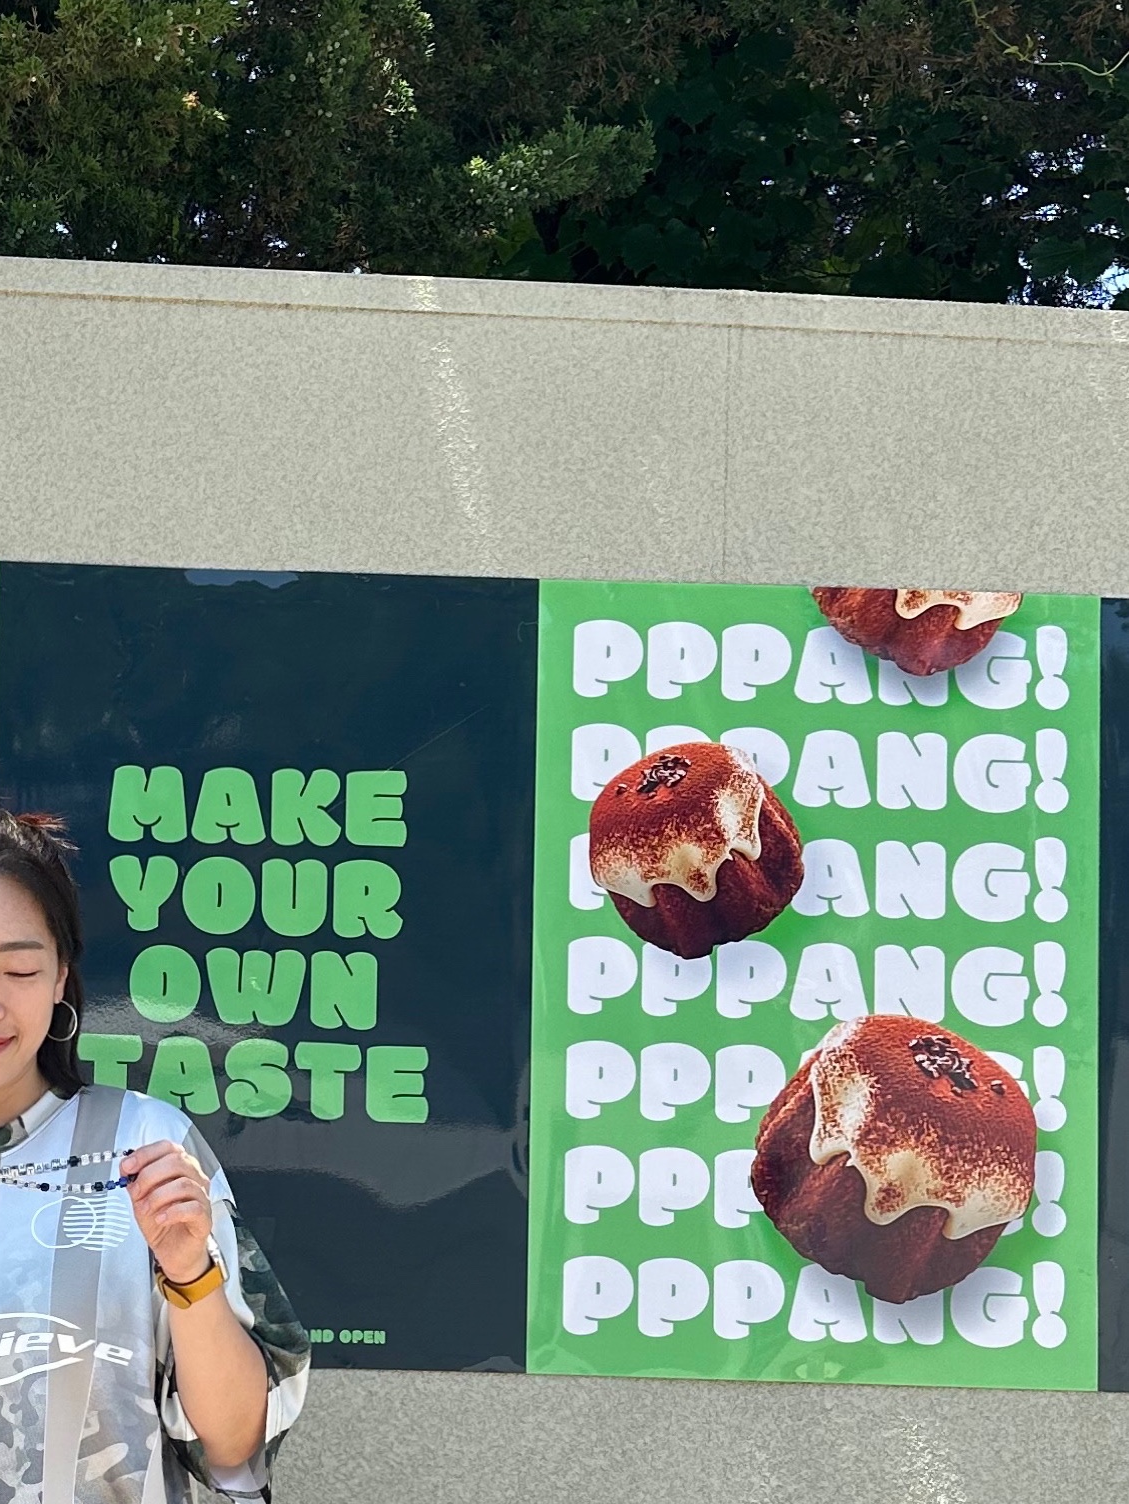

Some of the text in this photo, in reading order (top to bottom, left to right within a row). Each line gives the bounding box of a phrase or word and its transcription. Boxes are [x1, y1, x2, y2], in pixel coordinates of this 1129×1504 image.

[107, 764, 408, 848] MAKE
[570, 722, 1070, 814] PPANG!
[109, 854, 404, 940] YOUR
[129, 944, 378, 1031] OWN
[566, 935, 1068, 1028] PPPANG!
[77, 1032, 429, 1124] TASTE
[339, 1329, 386, 1345] OPEN
